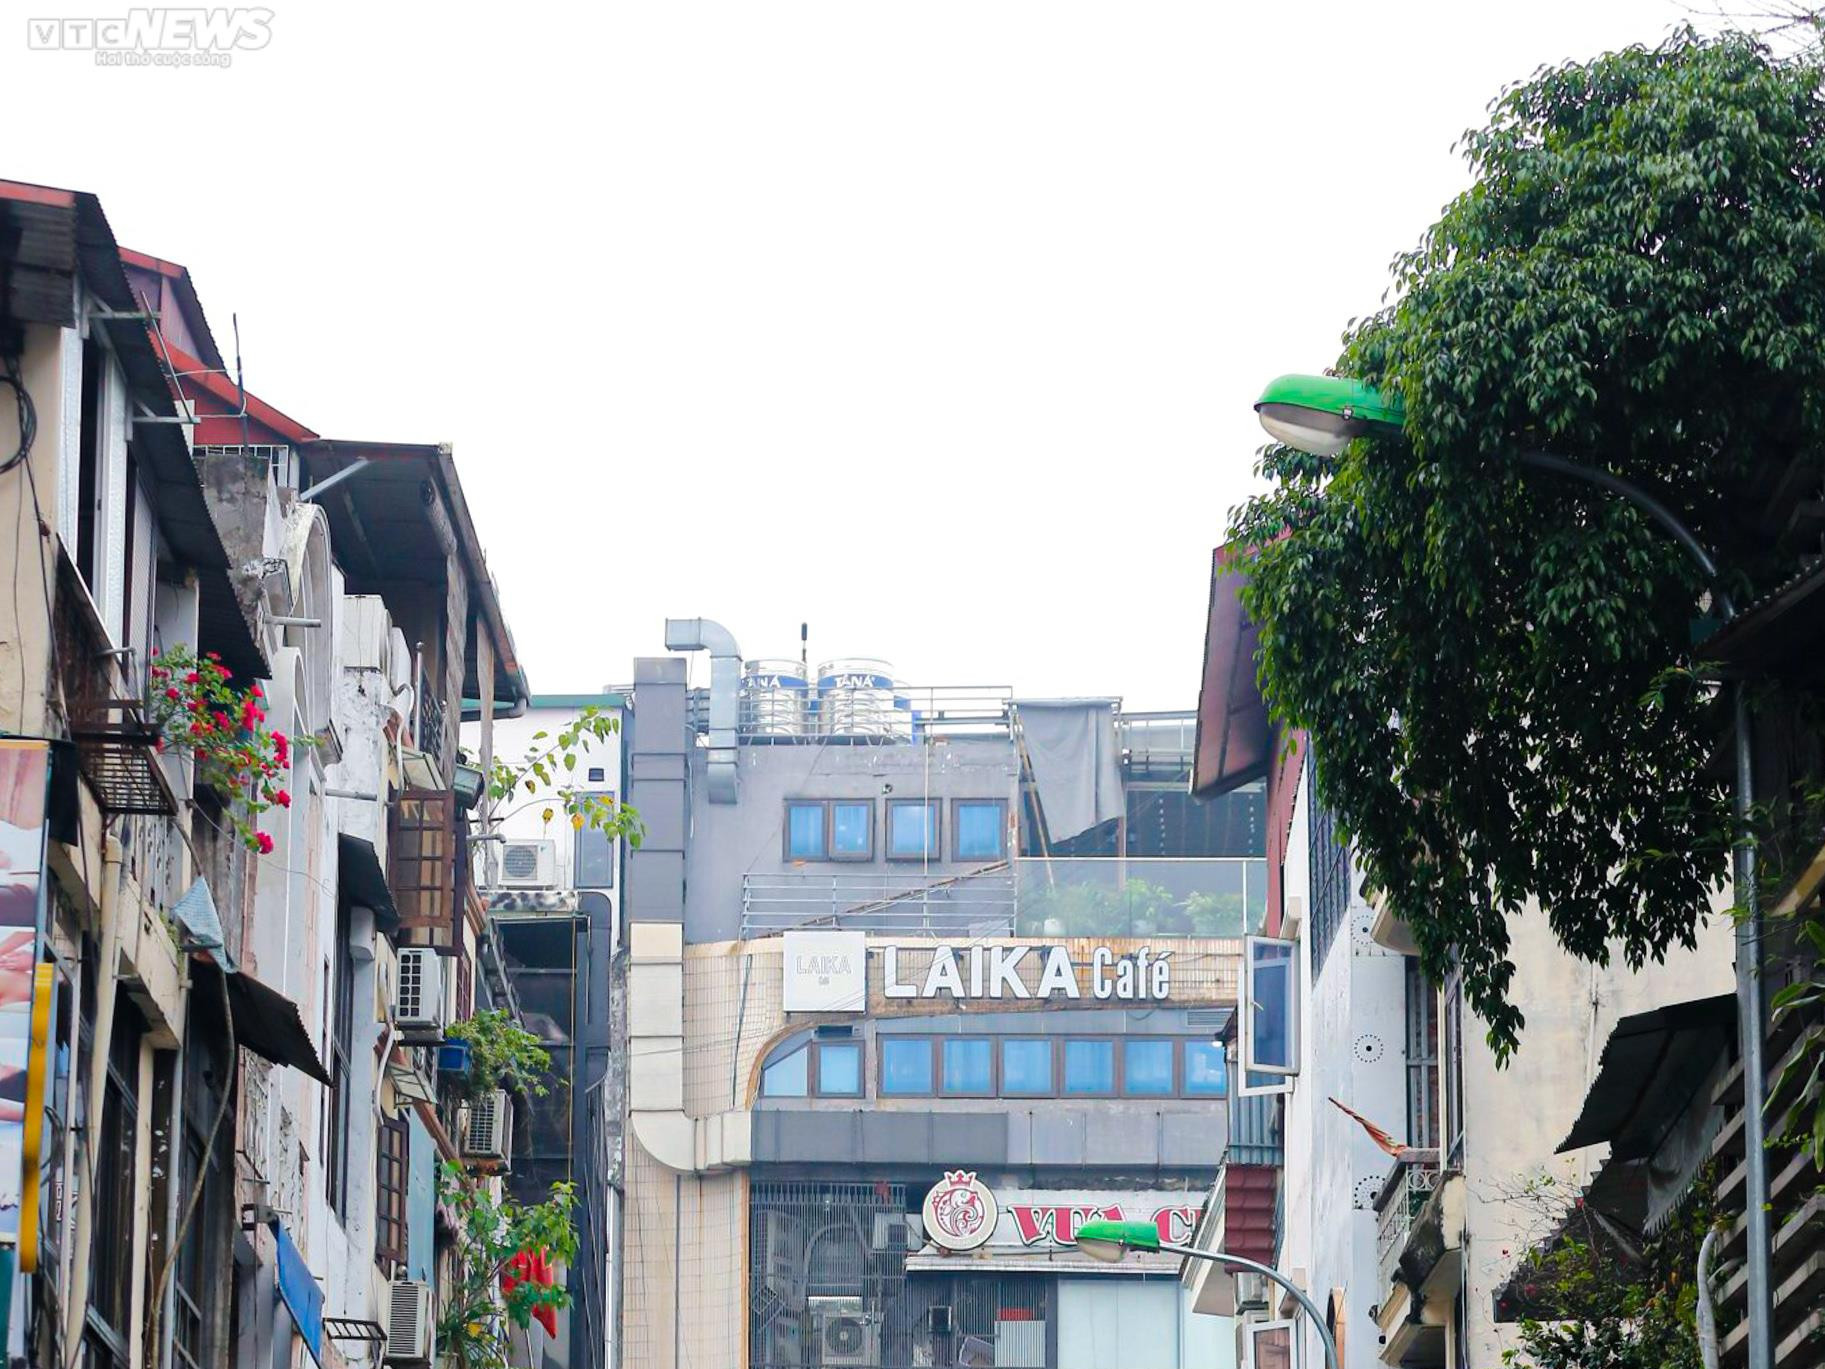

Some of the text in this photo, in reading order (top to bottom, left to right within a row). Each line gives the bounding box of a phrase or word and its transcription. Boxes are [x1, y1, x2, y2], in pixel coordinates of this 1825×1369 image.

[796, 954, 852, 975] LAIKA
[884, 945, 1175, 999] LAIKA Café
